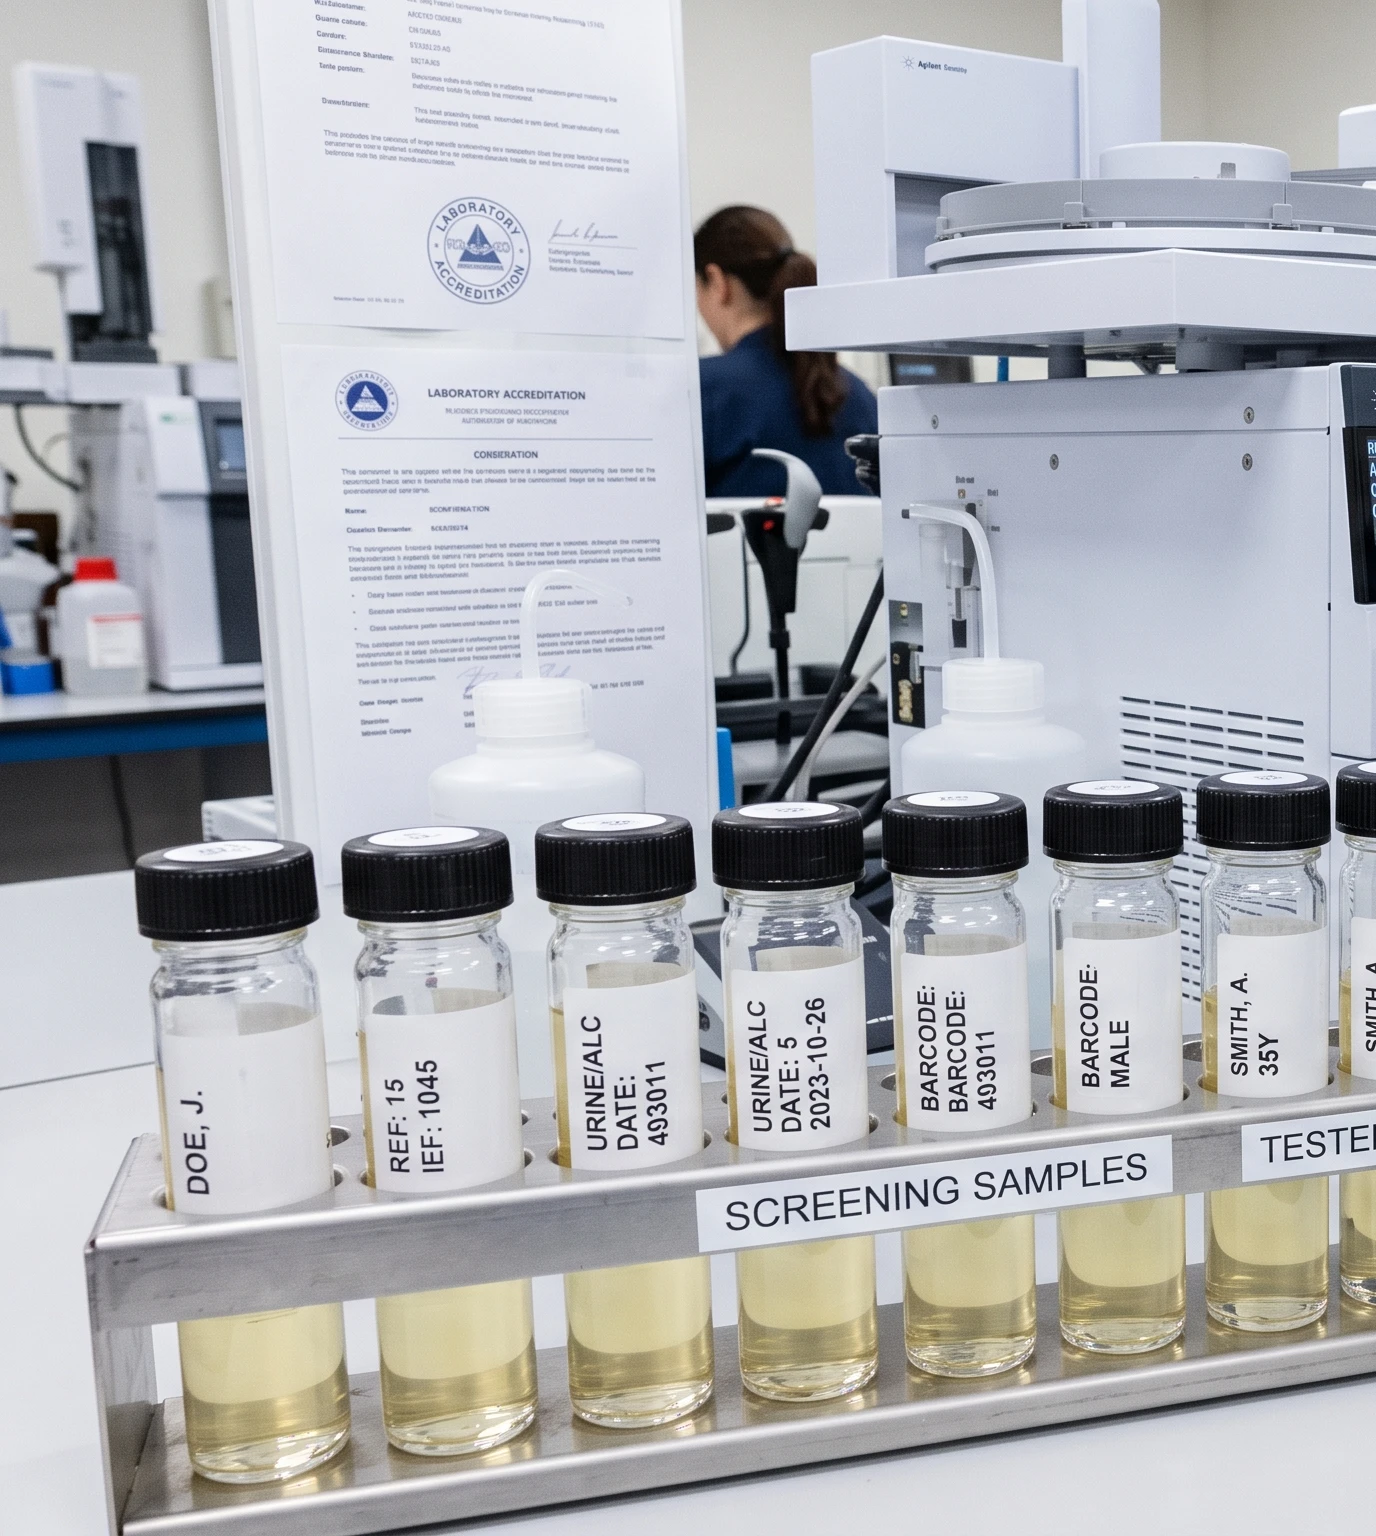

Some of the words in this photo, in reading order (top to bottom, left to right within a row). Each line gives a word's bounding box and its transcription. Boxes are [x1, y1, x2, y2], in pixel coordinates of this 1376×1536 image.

[436, 201, 520, 237] LABORATORY
[434, 259, 526, 301] ACCREDITATION
[427, 388, 501, 399] LABORATORY
[503, 390, 587, 401] ACCREDITATION
[1230, 972, 1248, 994] A.
[747, 1000, 773, 1132] URINE/ALC
[777, 1036, 798, 1050] 5
[804, 997, 831, 1131] 2023-10-26
[917, 985, 940, 1112] BARCODE:
[946, 990, 969, 1113] BARCODE:
[975, 1031, 998, 1111] 493011
[1109, 1020, 1130, 1088] MALE
[1230, 1001, 1252, 1077] SMITH,
[1258, 1032, 1279, 1076] 35Y
[180, 1091, 204, 1115] J.
[384, 1079, 405, 1106] 15
[415, 1060, 441, 1118] 1045
[580, 1015, 608, 1151] URINE/ALC
[614, 1075, 639, 1150] DATE:
[645, 1060, 669, 1147] 493011
[778, 1060, 802, 1133] DATE:
[184, 1125, 210, 1195] DOE,
[388, 1115, 411, 1173] REF:
[420, 1126, 444, 1173] IEF:
[725, 1175, 961, 1231] SCREENING
[973, 1152, 1149, 1201] SAMPLES
